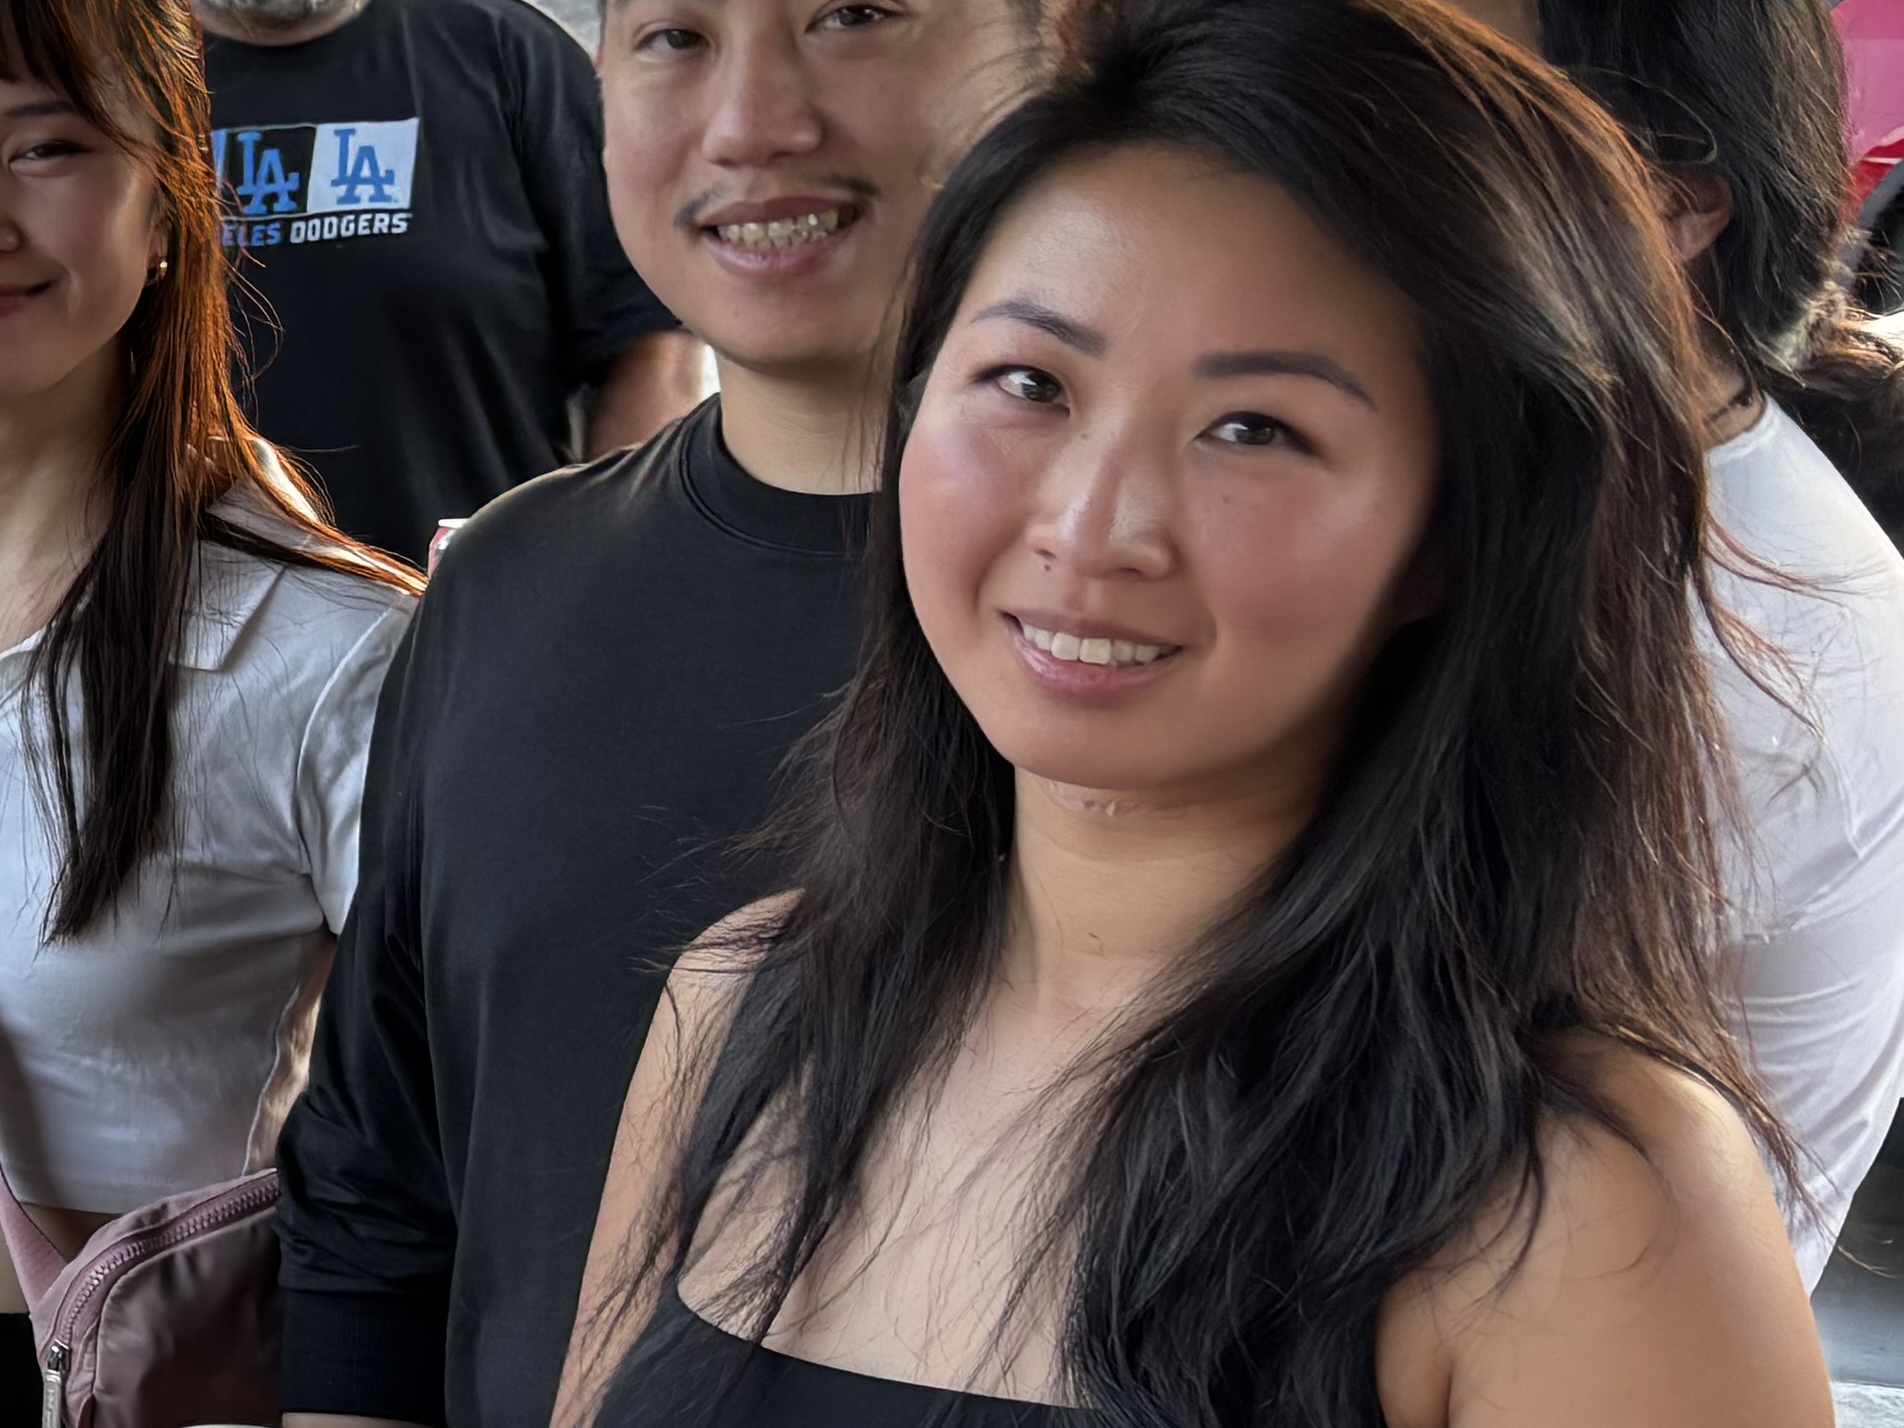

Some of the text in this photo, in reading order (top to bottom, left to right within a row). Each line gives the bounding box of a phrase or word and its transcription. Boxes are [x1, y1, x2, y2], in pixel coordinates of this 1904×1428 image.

[237, 130, 300, 215] LA
[330, 128, 397, 206] LA
[290, 213, 410, 243] DODGERS
